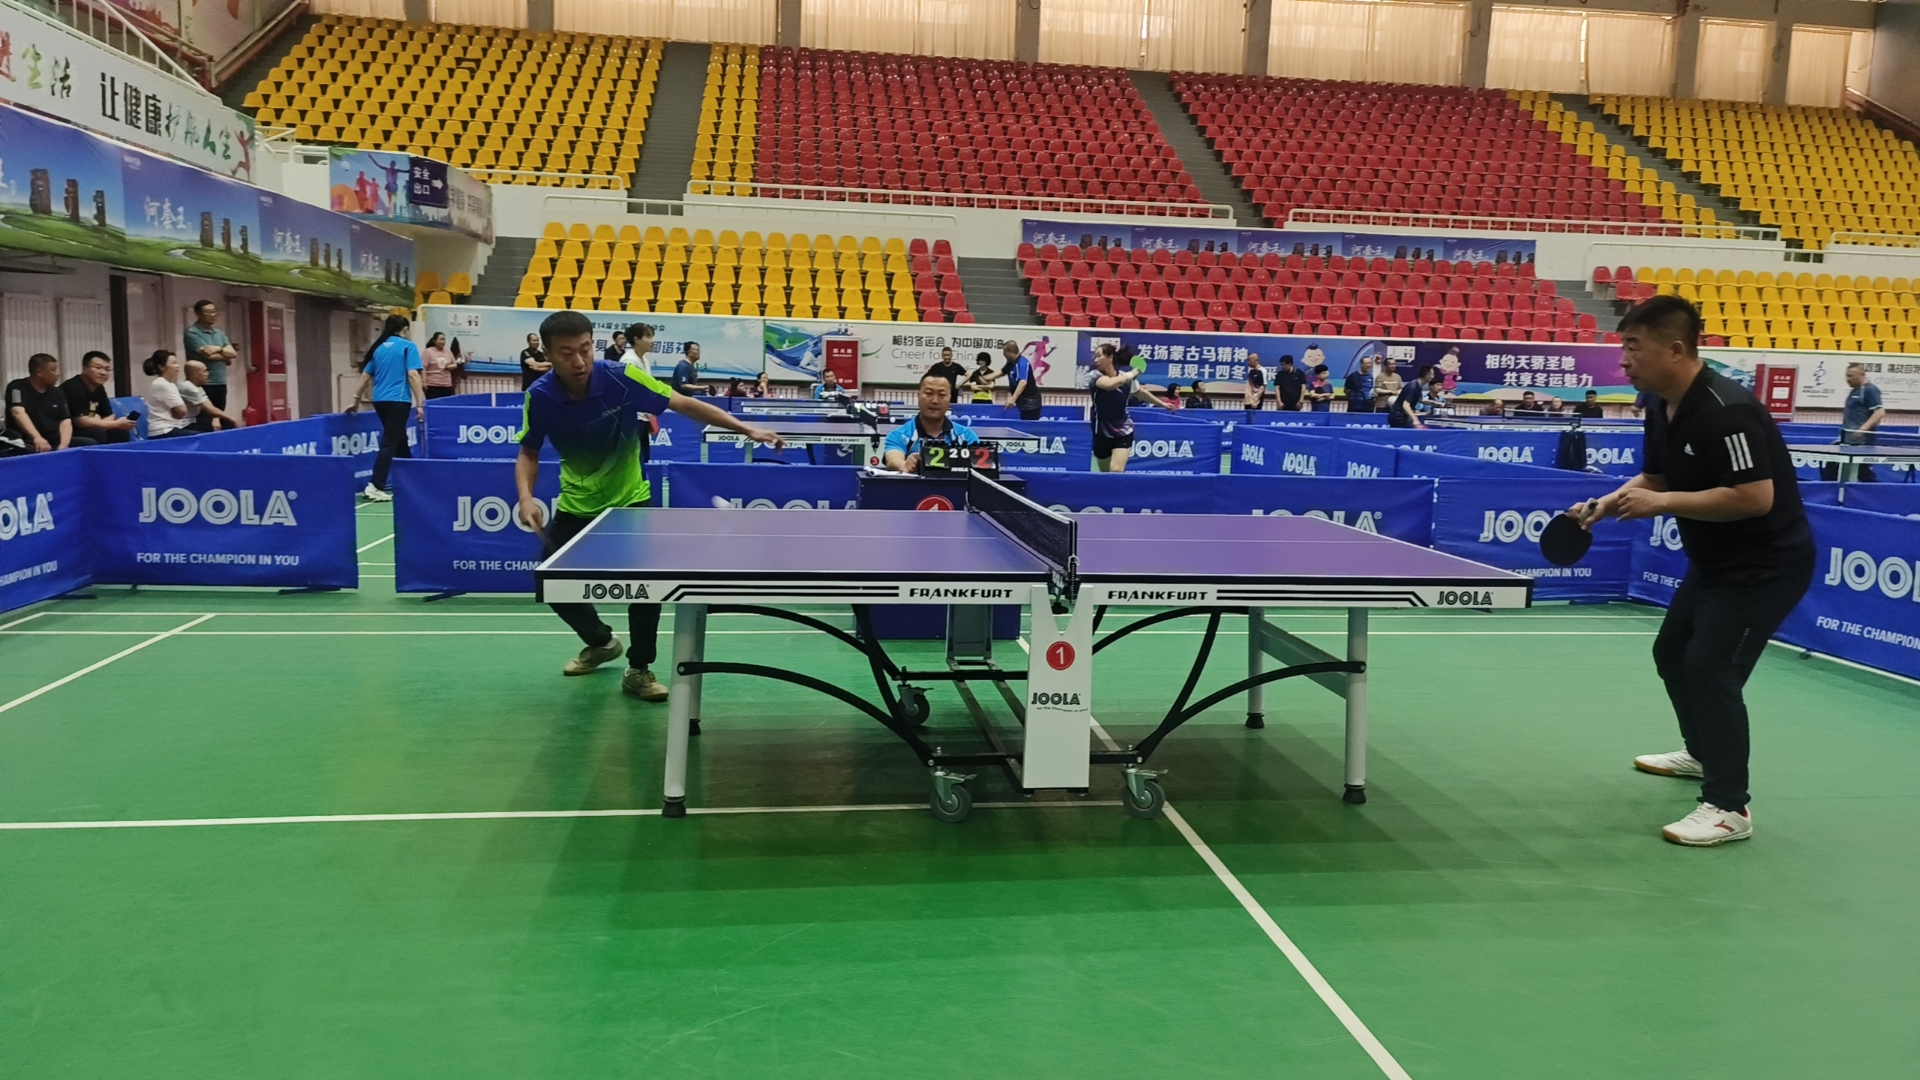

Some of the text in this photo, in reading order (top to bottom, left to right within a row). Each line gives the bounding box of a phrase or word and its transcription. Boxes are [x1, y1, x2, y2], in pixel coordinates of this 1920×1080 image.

[413, 167, 430, 180] 安全
[413, 183, 430, 195] 出口
[892, 335, 1004, 349] 相约冬运会 为中国加油
[891, 348, 926, 360] Cheer
[1138, 344, 1248, 362] 发扬蒙古马精神
[1485, 354, 1576, 371] 相约天骄圣地
[1168, 363, 1278, 380] 展现十四冬采
[1503, 371, 1593, 388] 共享冬运魅力
[457, 425, 519, 444] JOOL
[332, 432, 380, 456] JOOLA
[1129, 440, 1194, 458] JOOLA
[929, 447, 991, 469] 2 2 0 2
[1241, 443, 1265, 466] JOOLA
[1478, 446, 1534, 463] JOOLA
[1586, 447, 1635, 465] OOLA
[1282, 452, 1317, 476] JOOLA
[139, 487, 298, 526] JOOLA
[453, 496, 560, 532] JOO
[1479, 510, 1565, 543] JOO
[137, 553, 299, 566] FOR THE CHAMPION IN YOU
[453, 560, 476, 570] FOR
[479, 561, 502, 571] THE
[1572, 568, 1592, 577] YOU
[1643, 571, 1675, 587] FOR THE
[583, 584, 650, 599] JOOLA
[909, 587, 1013, 600] FRANKFURT
[1107, 590, 1208, 602] FRANKFURT
[1437, 591, 1494, 605] JOOLA
[1816, 616, 1840, 630] FOR
[1841, 621, 1863, 636] THE
[1055, 646, 1064, 665] 1
[1031, 692, 1081, 705] JOOLA
